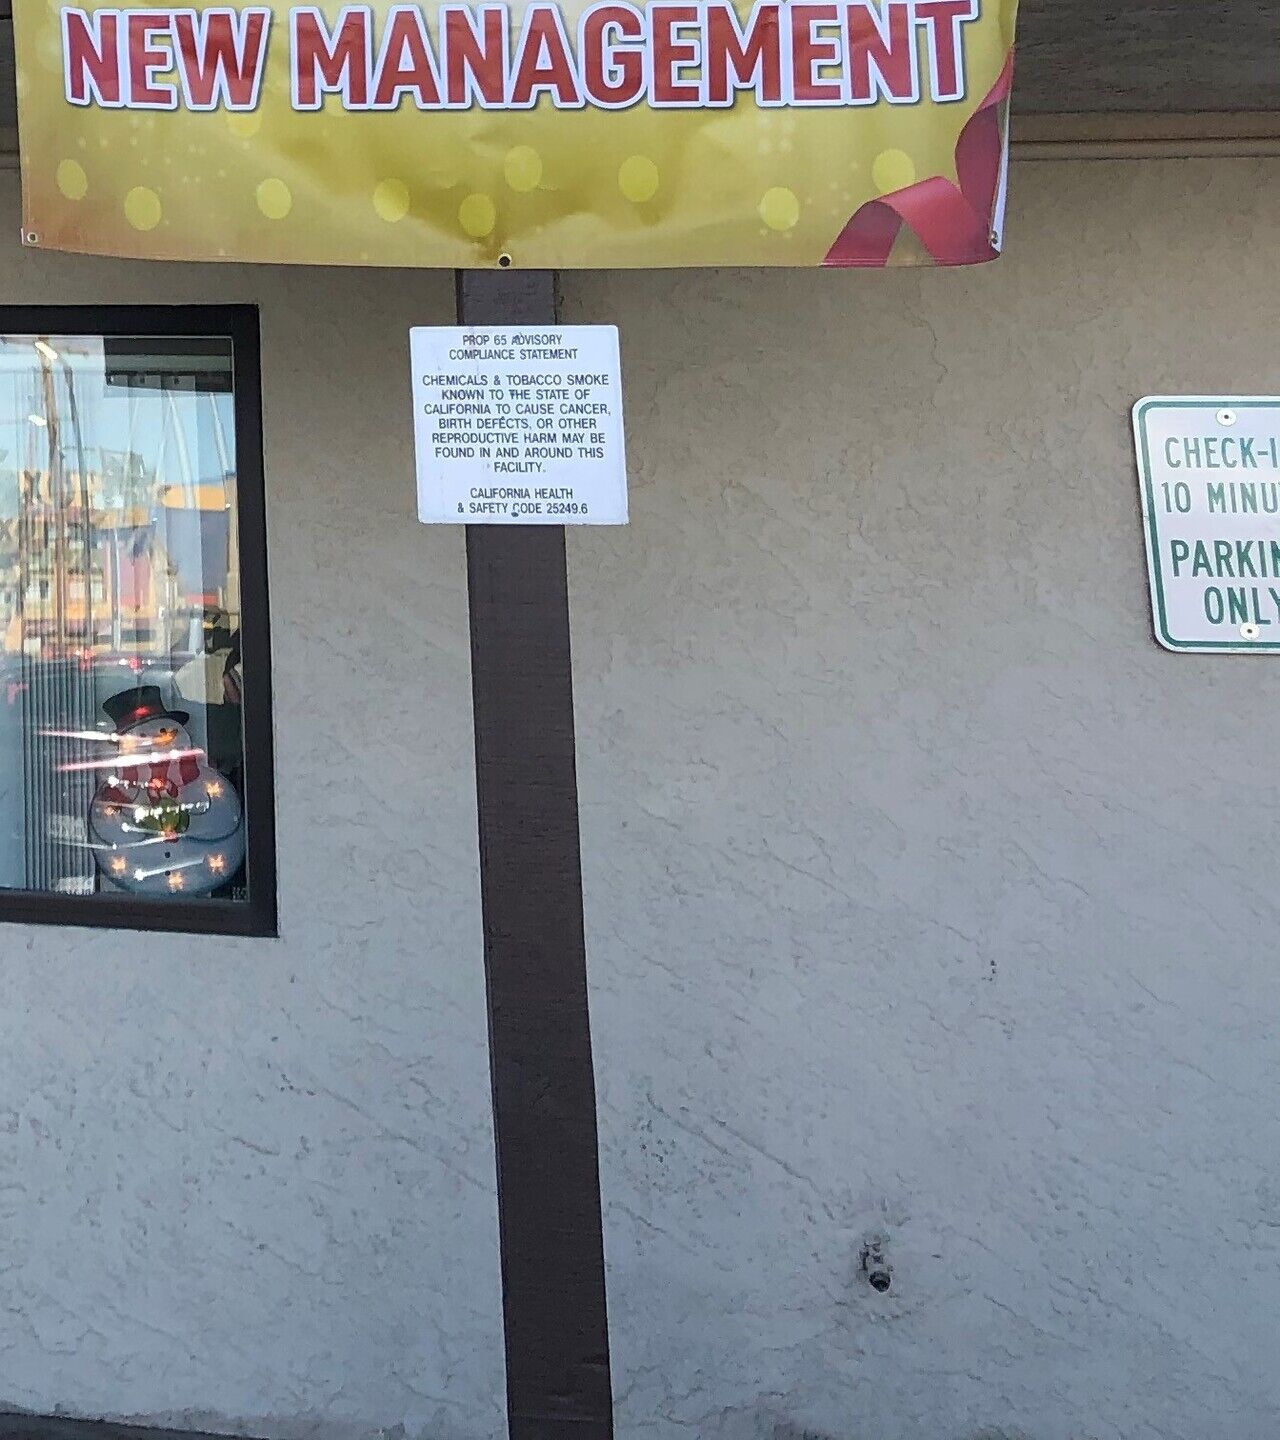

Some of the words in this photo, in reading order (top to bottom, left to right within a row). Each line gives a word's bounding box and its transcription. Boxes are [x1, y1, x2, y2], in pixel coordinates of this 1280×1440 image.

[60, 3, 272, 112] NEW
[462, 335, 489, 346] PROP
[494, 335, 507, 346] 65
[511, 335, 562, 345] ADVISORY
[449, 349, 515, 360] COMPLIANCE
[520, 349, 578, 359] STATEMENT
[422, 375, 488, 386] CHEMICALS
[494, 375, 501, 385] &
[507, 375, 562, 385] TOBACCO
[567, 375, 609, 385] SMOKE
[442, 390, 484, 400] KNOWN
[490, 390, 504, 400] TO
[510, 389, 531, 400] THE
[536, 389, 569, 400] STATE
[575, 389, 590, 399] OF
[424, 404, 490, 414] CALIFORNIA
[496, 404, 510, 414] TO
[516, 404, 554, 414] CAUSE
[560, 404, 611, 416] CANCER,
[440, 419, 471, 429] BIRTH
[537, 418, 553, 429] OR
[559, 418, 597, 429] OTHER
[432, 433, 519, 444] REPRODUCTIVE
[524, 433, 557, 443] HARM
[562, 433, 585, 443] MAY
[590, 433, 605, 443] BE
[435, 448, 475, 458] FOUND
[480, 448, 490, 458] IN
[496, 447, 519, 458] AND
[525, 447, 573, 458] AROUND
[578, 447, 604, 458] THIS
[1165, 437, 1280, 468] CHECK-I
[471, 489, 530, 499] CALIFORNIA
[535, 488, 573, 499] HEALTH
[1162, 482, 1191, 513] 10
[1207, 482, 1280, 513] MINU
[458, 503, 464, 513] &
[469, 503, 508, 514] SAFETY
[513, 503, 542, 514] CODE
[547, 503, 588, 514] 25249.6
[1171, 540, 1280, 578] PARKIN
